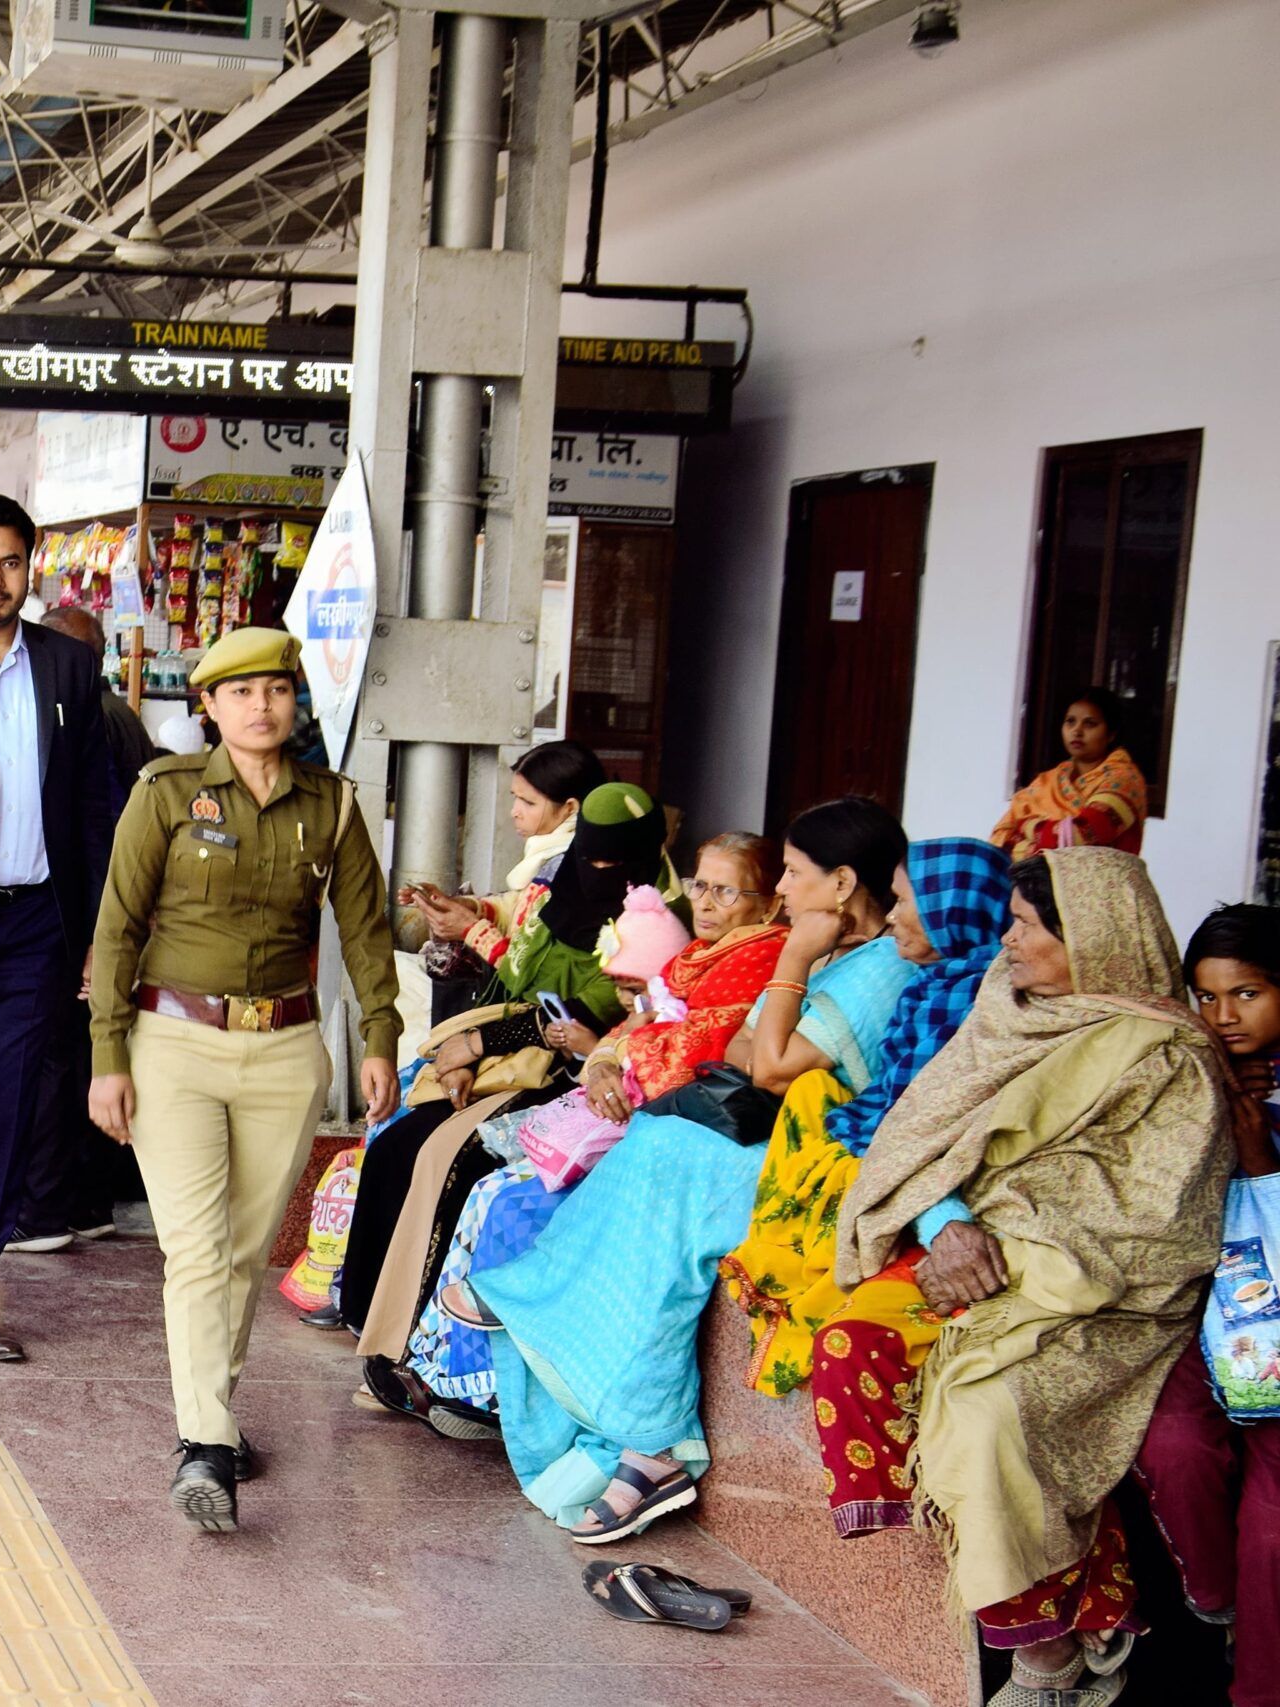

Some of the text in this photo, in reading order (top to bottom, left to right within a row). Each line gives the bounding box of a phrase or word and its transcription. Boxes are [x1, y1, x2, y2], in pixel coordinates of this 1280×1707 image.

[131, 321, 268, 348] TRAIN NAME
[562, 339, 607, 361] TIME
[612, 342, 644, 363] A/D
[128, 348, 234, 390] स्टेशन
[240, 358, 288, 391] पर
[261, 421, 316, 452] एच.
[290, 464, 326, 480] बक
